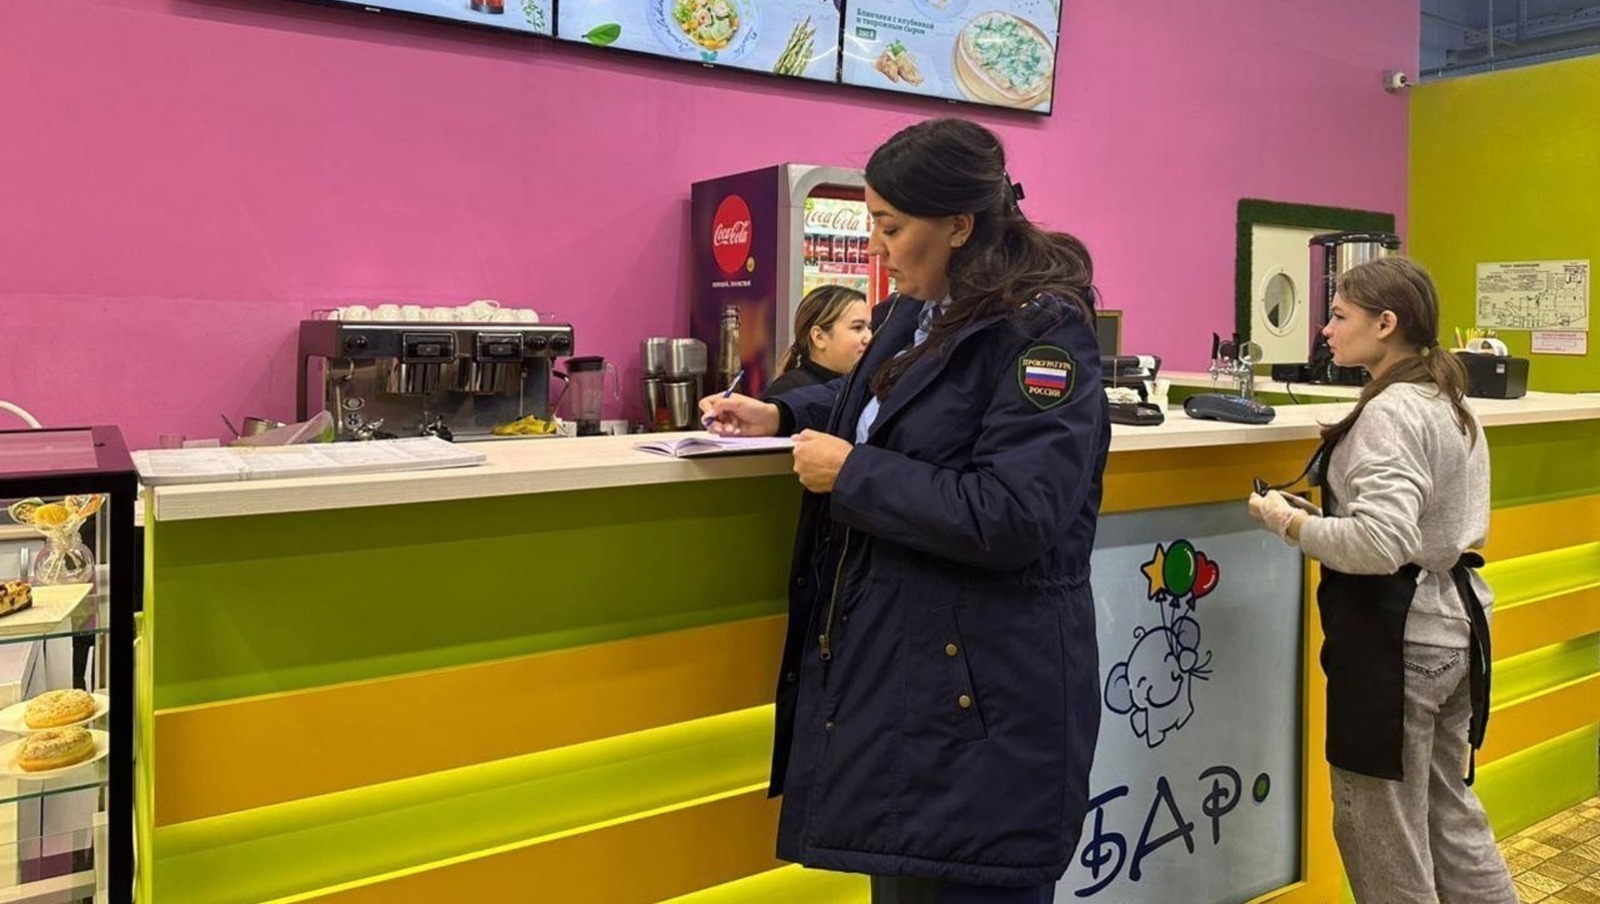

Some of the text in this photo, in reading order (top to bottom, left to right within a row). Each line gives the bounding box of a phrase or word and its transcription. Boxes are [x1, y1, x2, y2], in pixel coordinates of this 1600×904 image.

[863, 18, 902, 30] творожным
[904, 26, 925, 35] сыром
[898, 17, 934, 29] клубникой
[1022, 358, 1072, 371] ПРОКУРАТУРА
[1029, 386, 1061, 397] РОССИИ
[1074, 765, 1242, 898] БАР
